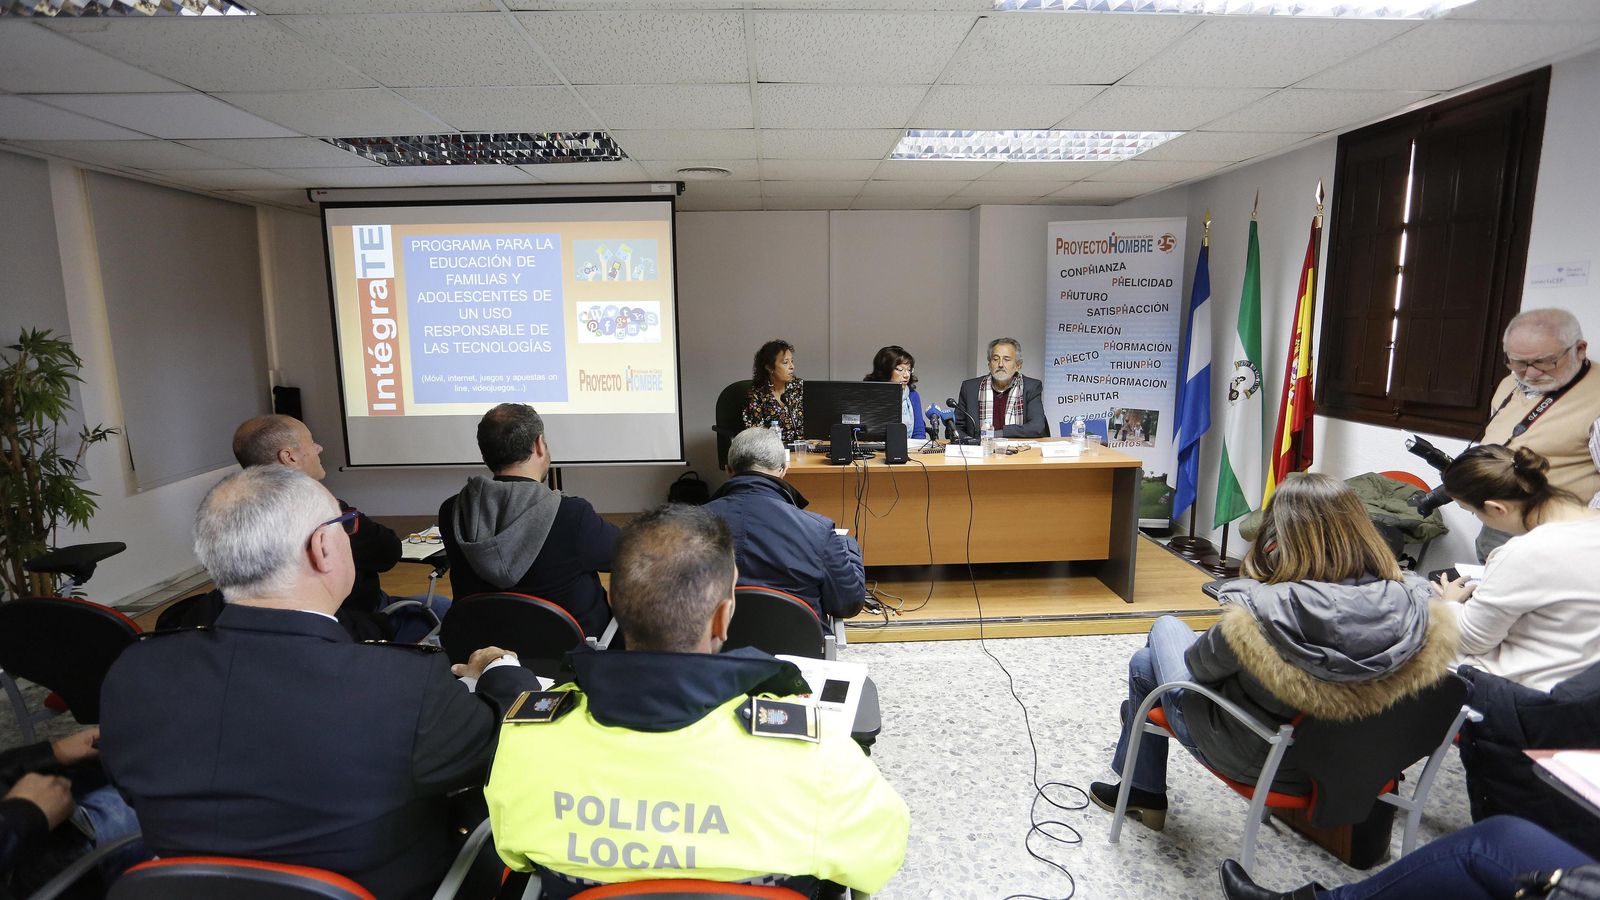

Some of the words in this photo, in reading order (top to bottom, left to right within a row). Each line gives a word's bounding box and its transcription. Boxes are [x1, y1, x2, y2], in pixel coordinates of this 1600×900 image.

[411, 239, 492, 252] PROGRAMA
[496, 238, 533, 251] PARA
[536, 238, 553, 250] LA
[429, 254, 512, 269] EDUCACIÓN
[517, 255, 536, 268] DE
[1060, 262, 1127, 279] CONPHIANZA
[446, 273, 508, 286] FAMILIAS
[512, 273, 521, 285] Y
[1112, 276, 1173, 288] PHELICIDAD
[417, 290, 528, 303] ADOLESCENTES
[533, 289, 552, 302] DE
[1060, 289, 1108, 302] PHUTURO
[458, 308, 479, 320] UN
[483, 307, 512, 320] USO
[424, 324, 525, 337] RESPONSABLE
[530, 324, 549, 336] DE
[423, 342, 449, 354] LAS
[453, 339, 552, 354] TECNOLOGÍAS
[1053, 350, 1100, 367] APHECTO
[1110, 358, 1162, 370] TRIUNPHO
[421, 374, 446, 384] (Móvil,
[479, 374, 504, 384] juegos
[505, 375, 511, 383] y
[512, 374, 546, 384] apuestas
[548, 374, 558, 382] on
[579, 369, 622, 392] PROYECTO
[625, 365, 663, 392] HOMBRE
[454, 384, 470, 393] line,
[1057, 391, 1119, 405] DISPHRUTAR
[1536, 397, 1553, 413] EOS
[1062, 410, 1114, 424] Crciendo
[1108, 440, 1141, 449] juntos
[553, 791, 730, 835] POLICIA
